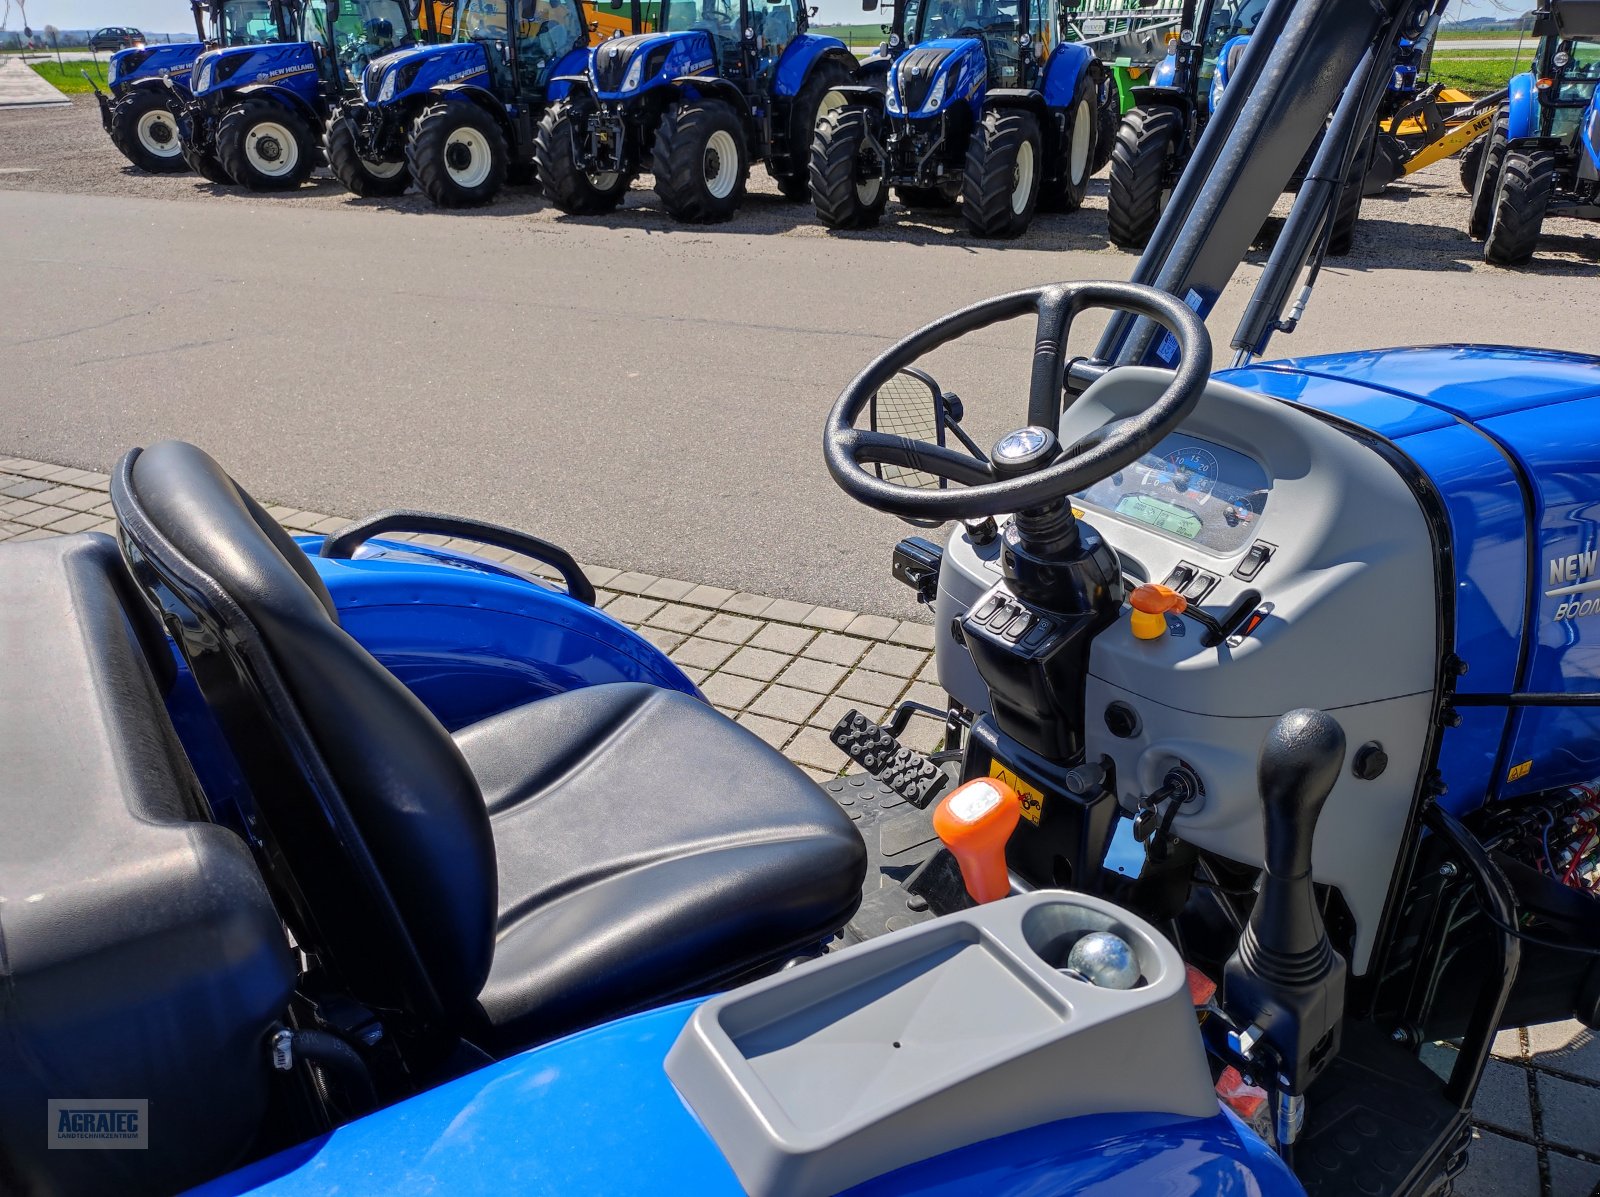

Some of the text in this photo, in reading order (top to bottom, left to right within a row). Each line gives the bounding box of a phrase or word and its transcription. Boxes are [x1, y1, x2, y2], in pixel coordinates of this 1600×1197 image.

[269, 63, 314, 77] NEW HOLLAND
[1176, 456, 1184, 464] 10
[1190, 454, 1200, 462] 15
[1198, 464, 1208, 472] 20
[1550, 550, 1597, 585] NEW
